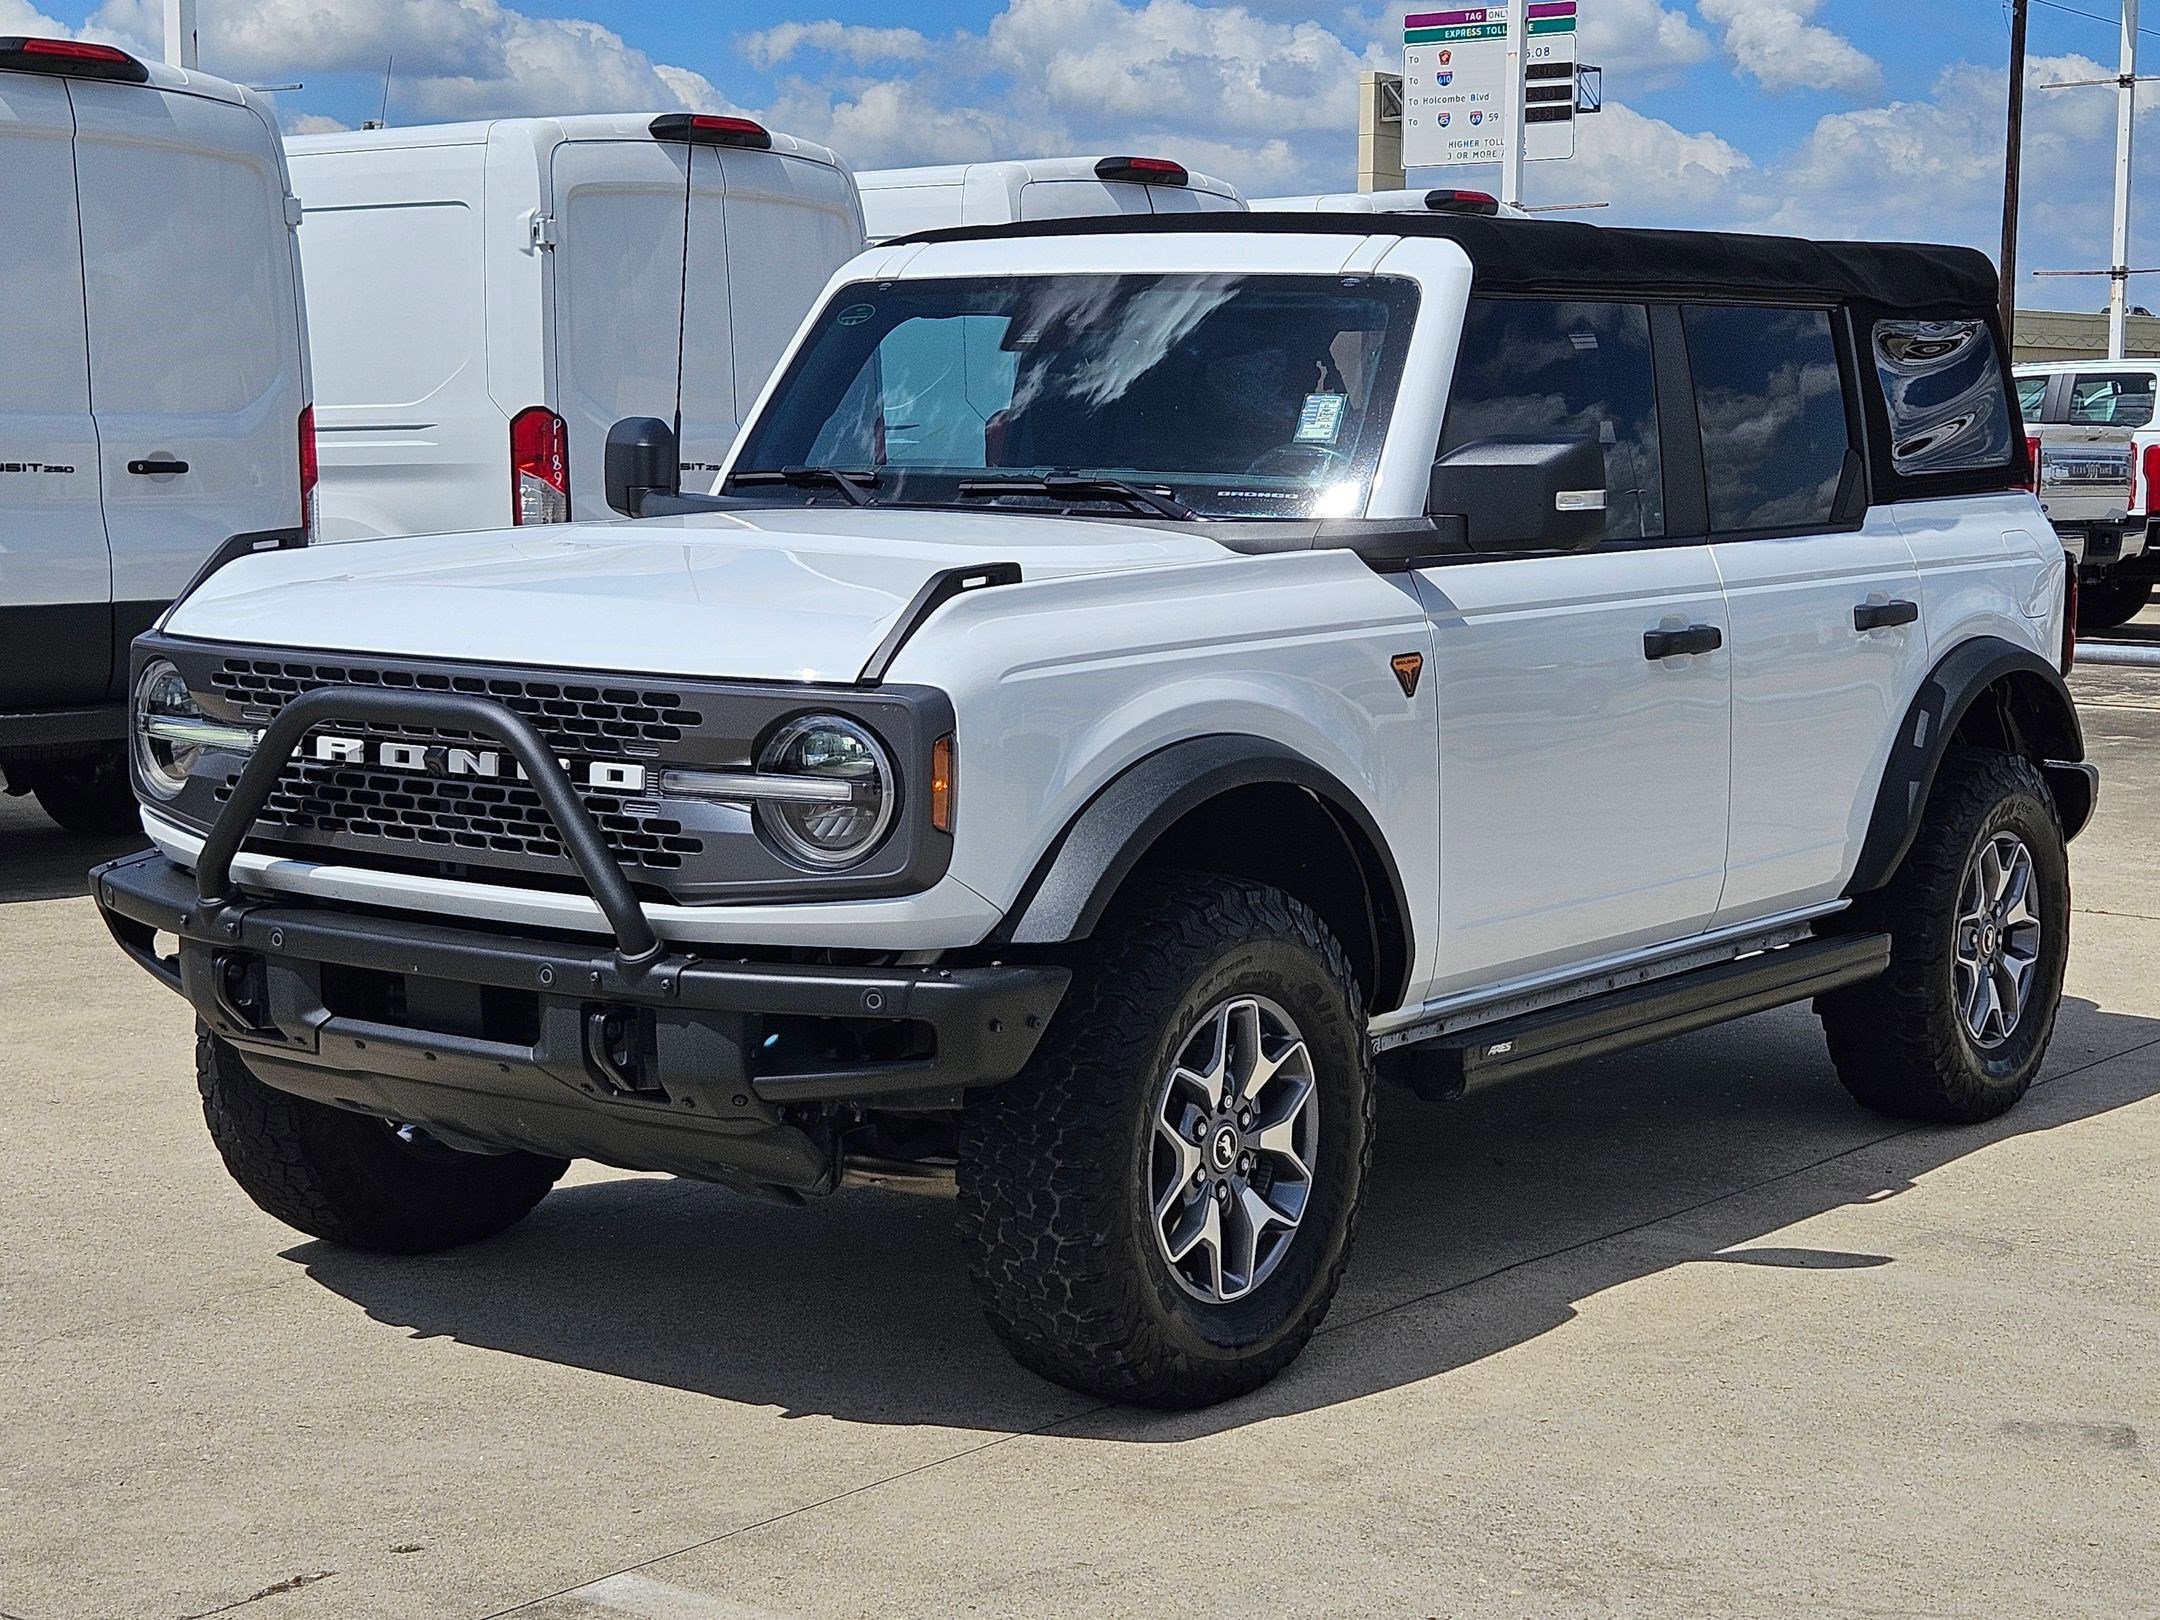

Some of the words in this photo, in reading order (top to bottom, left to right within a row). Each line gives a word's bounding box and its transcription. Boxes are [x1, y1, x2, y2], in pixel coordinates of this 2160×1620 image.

[1465, 12, 1482, 21] TAG
[1445, 28, 1482, 38] EXPRESS
[1486, 26, 1508, 35] TOLL
[1438, 75, 1451, 84] 610
[1423, 95, 1466, 105] Holcombe
[1470, 92, 1490, 102] Blvd
[1471, 114, 1481, 124] 69
[1488, 112, 1499, 122] 59
[1448, 140, 1480, 149] HIGHER
[1484, 138, 1505, 147] TOLL
[1456, 151, 1468, 160] OR
[1472, 150, 1497, 159] MORE
[0, 463, 43, 473] SIT
[257, 729, 646, 791] RONO
